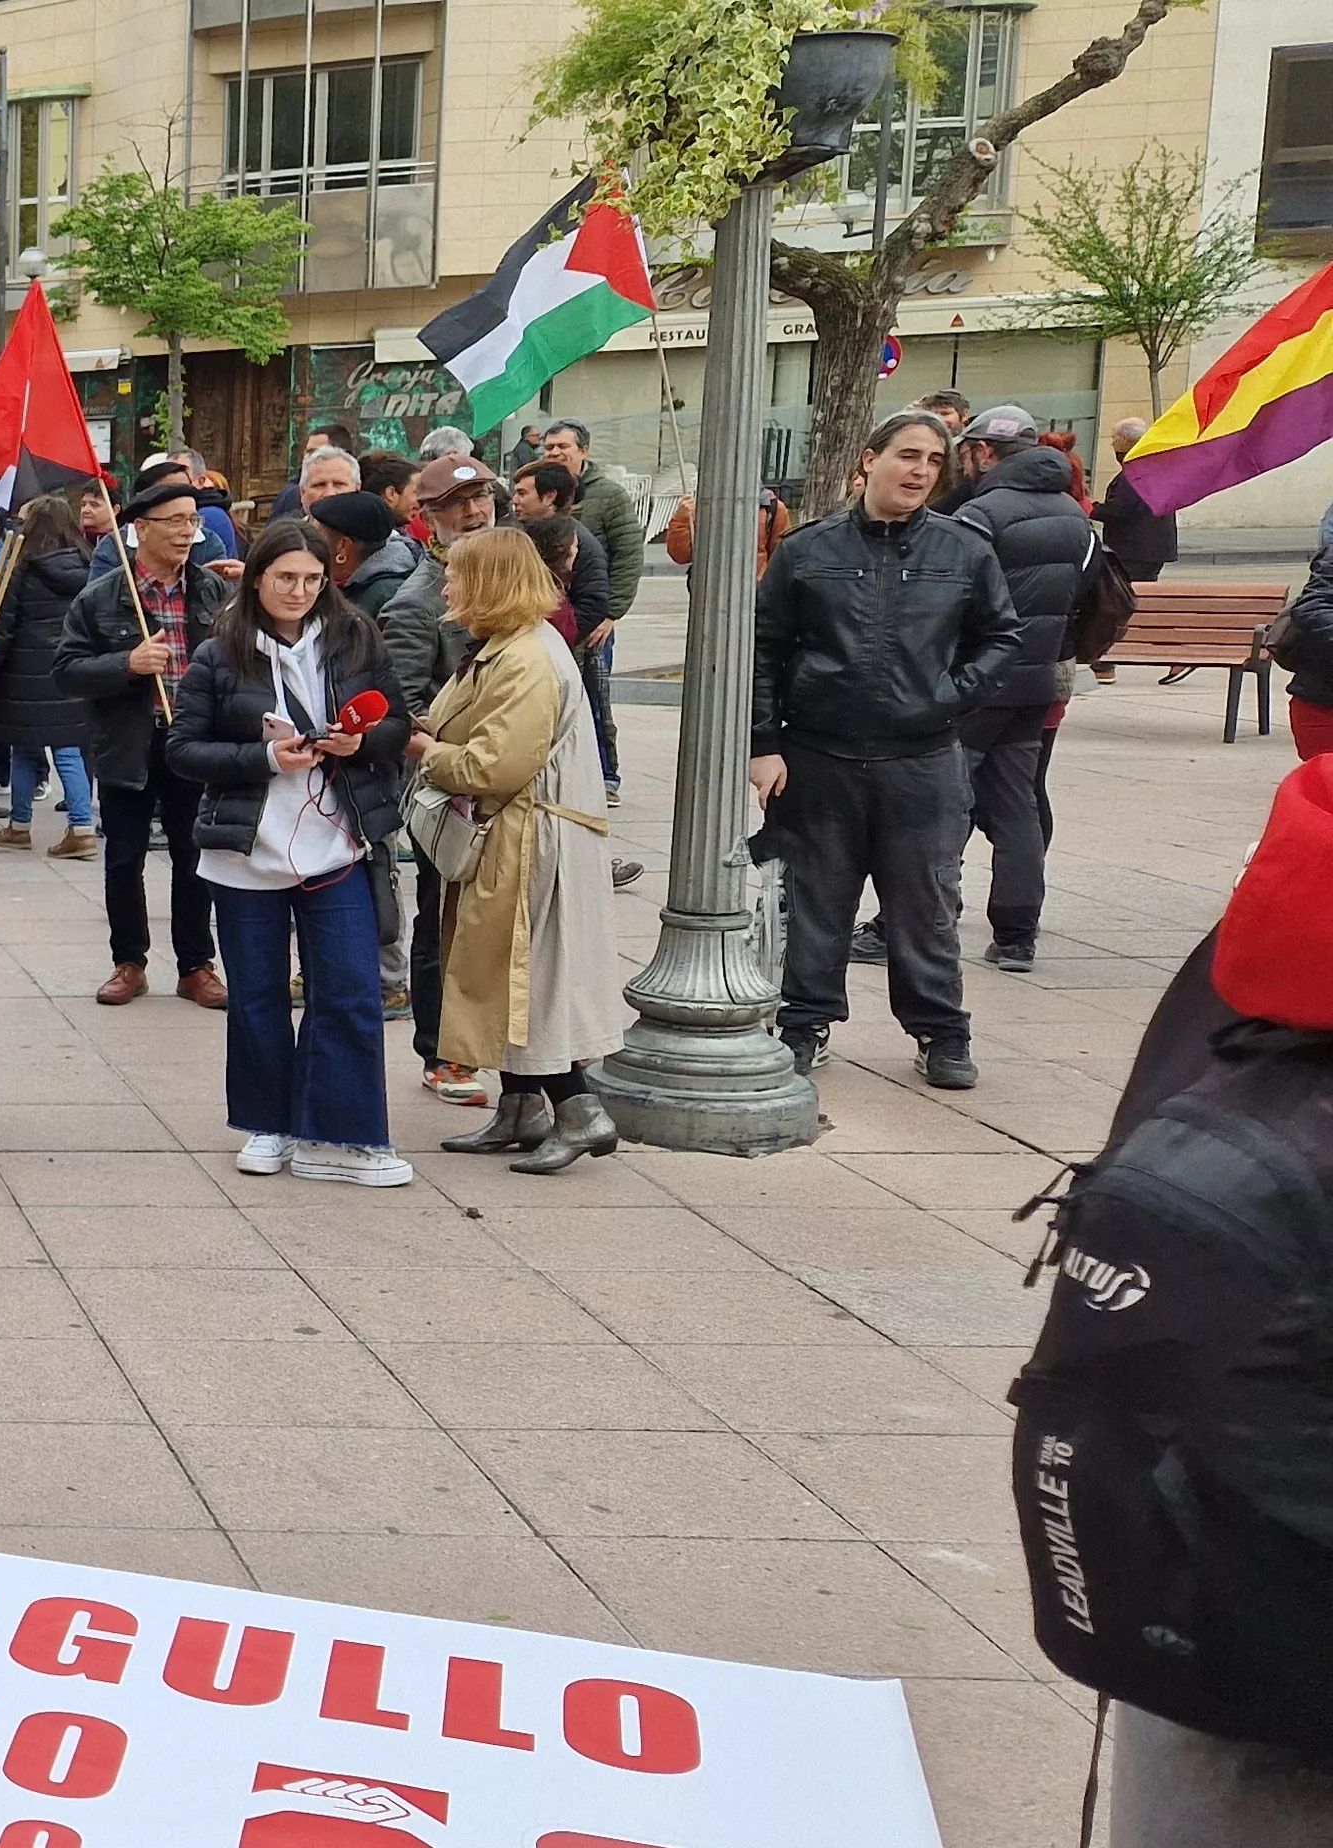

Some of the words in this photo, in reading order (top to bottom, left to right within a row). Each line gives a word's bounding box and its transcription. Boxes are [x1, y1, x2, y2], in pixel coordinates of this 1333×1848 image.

[649, 329, 706, 342] RESTAU
[1053, 1441, 1074, 1467] 10
[1036, 1470, 1095, 1636] LEADVILLE
